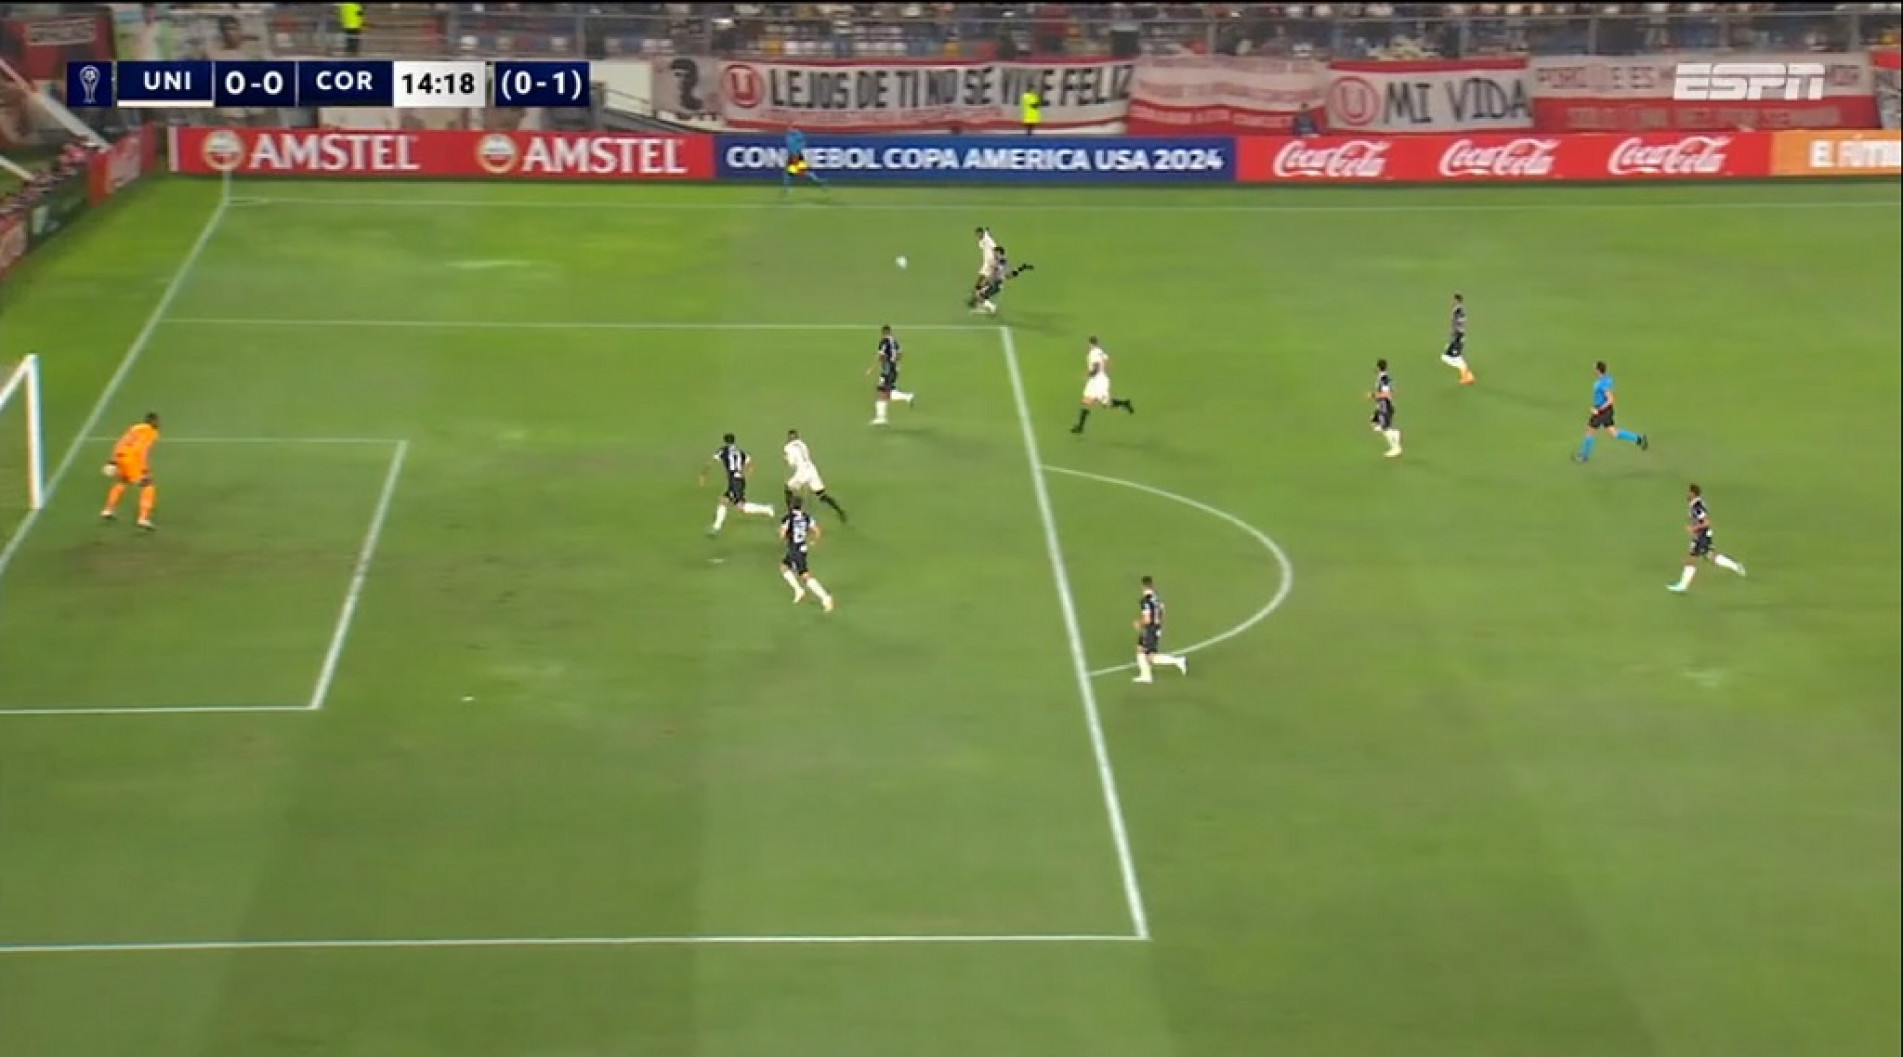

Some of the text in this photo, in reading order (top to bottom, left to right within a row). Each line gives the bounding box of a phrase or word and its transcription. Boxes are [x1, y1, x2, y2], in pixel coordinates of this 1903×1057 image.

[768, 68, 848, 109] LEJOS
[856, 70, 889, 108] DE
[894, 69, 920, 108] TI
[1059, 64, 1133, 107] FELIZ
[1382, 81, 1432, 124] MI
[1443, 77, 1532, 123] VIDA
[249, 132, 421, 171] AMSTEL
[521, 136, 688, 174] AMSTEL
[726, 146, 1224, 171] CONEBOL COPA AMERICA USA 2024
[1809, 139, 1833, 168] EL
